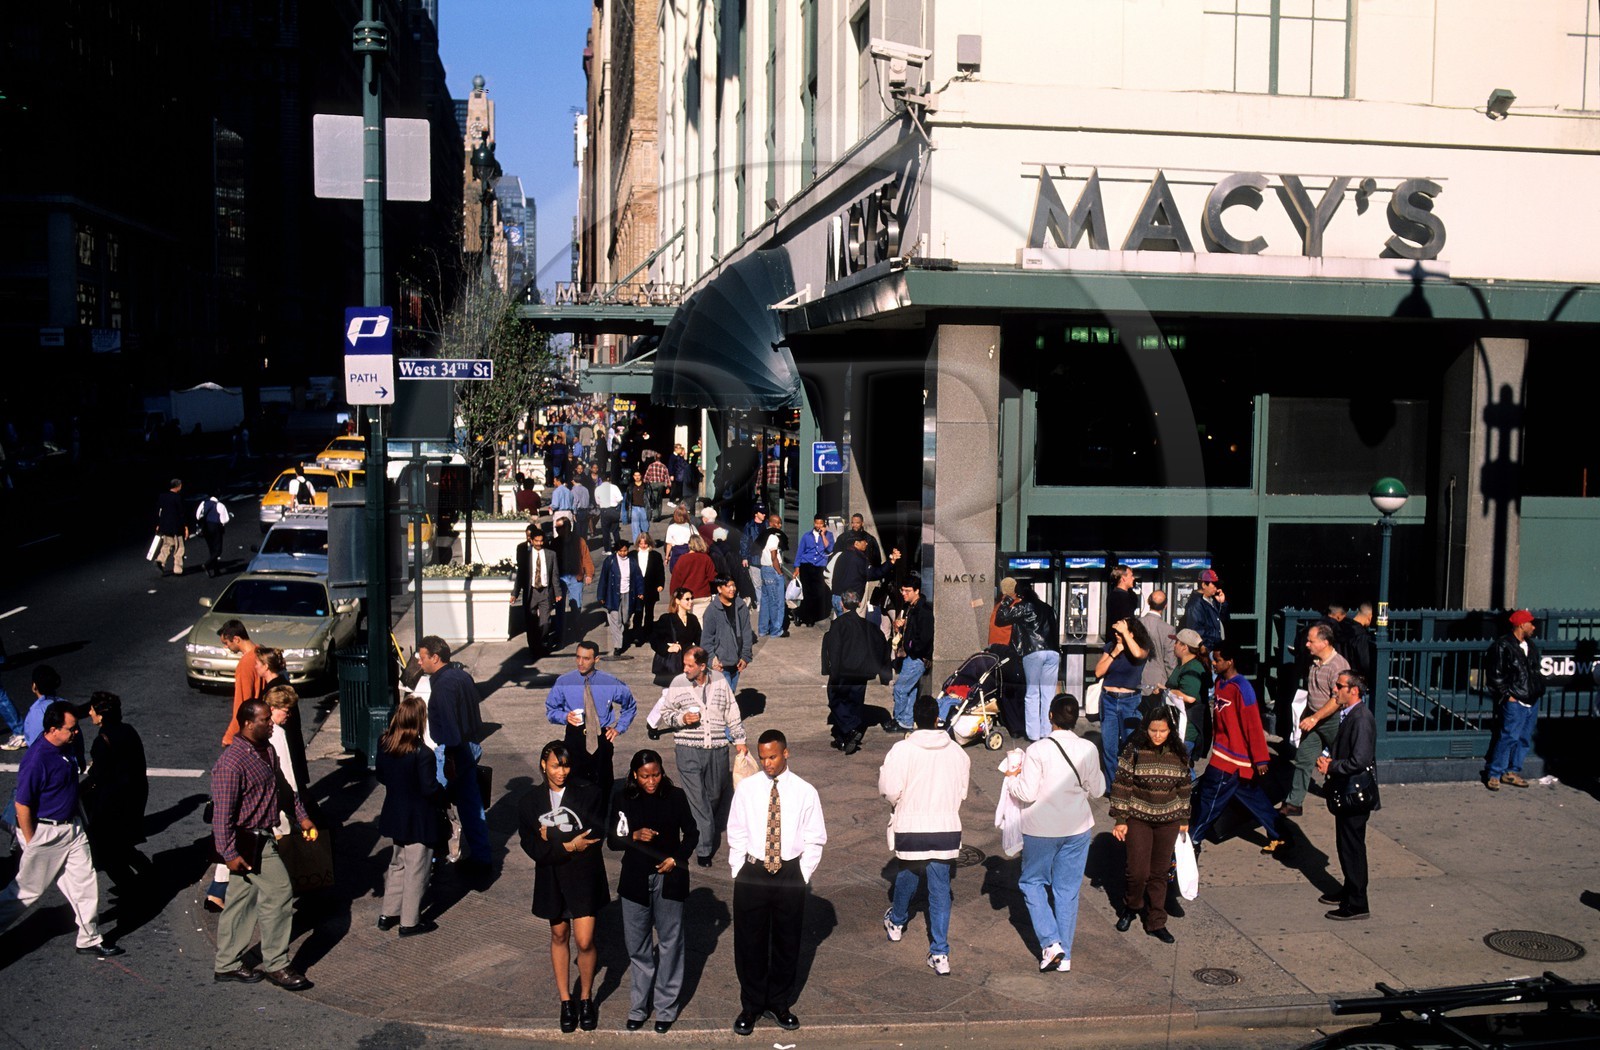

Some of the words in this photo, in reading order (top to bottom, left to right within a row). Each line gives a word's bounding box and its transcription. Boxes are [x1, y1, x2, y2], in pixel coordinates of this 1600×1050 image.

[1026, 164, 1447, 260] MACY'S
[555, 281, 682, 304] MACY'S
[350, 373, 378, 383] PATH
[399, 362, 437, 376] West
[440, 362, 469, 377] 34TH
[473, 363, 490, 377] St
